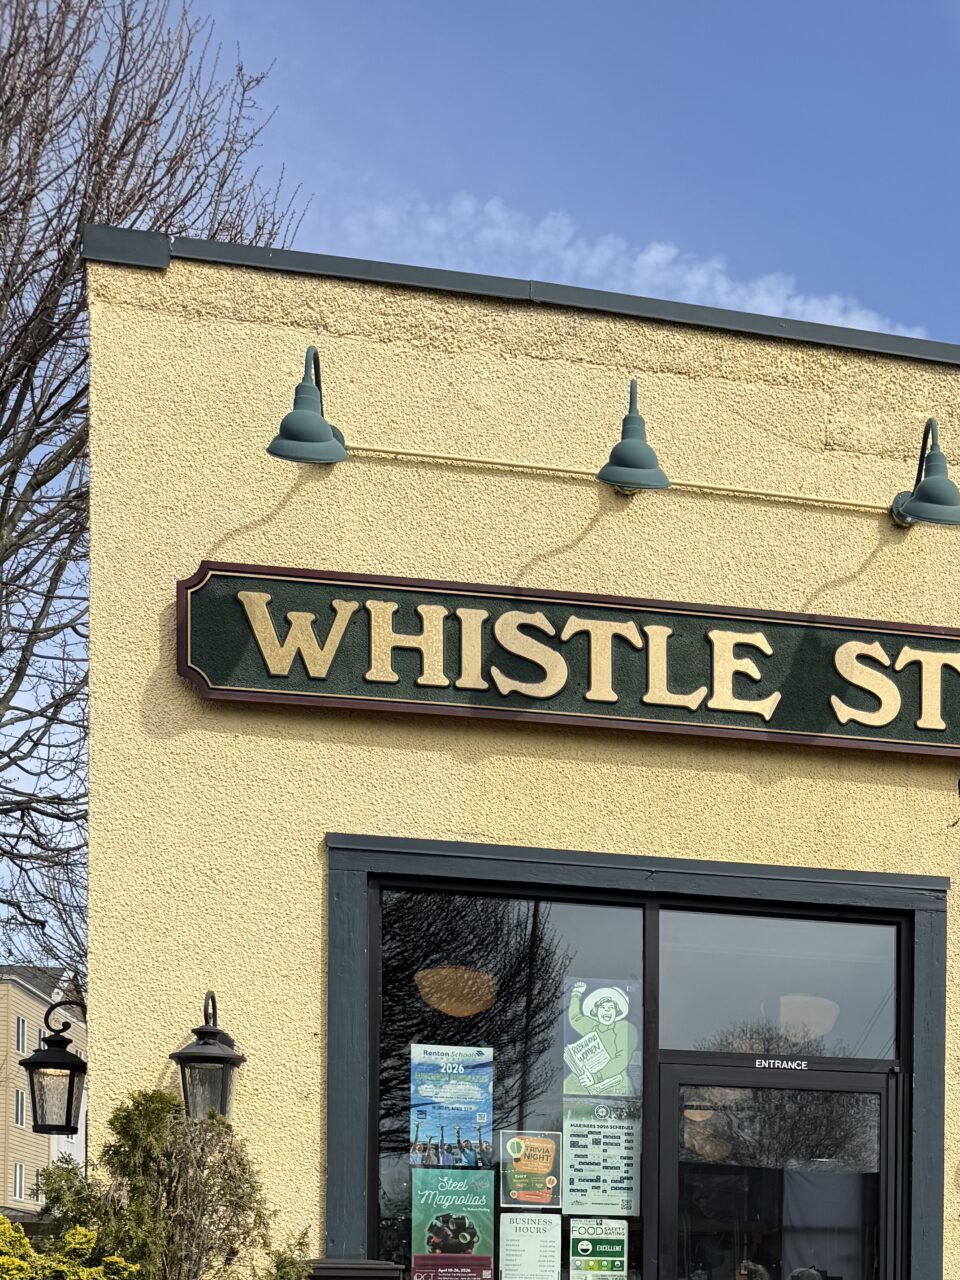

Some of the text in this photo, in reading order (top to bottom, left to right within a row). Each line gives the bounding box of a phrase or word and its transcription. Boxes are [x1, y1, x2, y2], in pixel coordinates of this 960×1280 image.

[237, 591, 782, 721] WHISTLE
[440, 1063, 465, 1074] 2026
[755, 1059, 808, 1070] ENTRANCE
[525, 1146, 550, 1154] TRIVIA
[524, 1153, 552, 1162] NIGHT
[438, 1177, 469, 1191] Steel
[418, 1190, 487, 1209] Magnolias
[509, 1217, 553, 1226] BUSINESS
[515, 1226, 547, 1234] HOURS
[571, 1226, 604, 1236] FOOD
